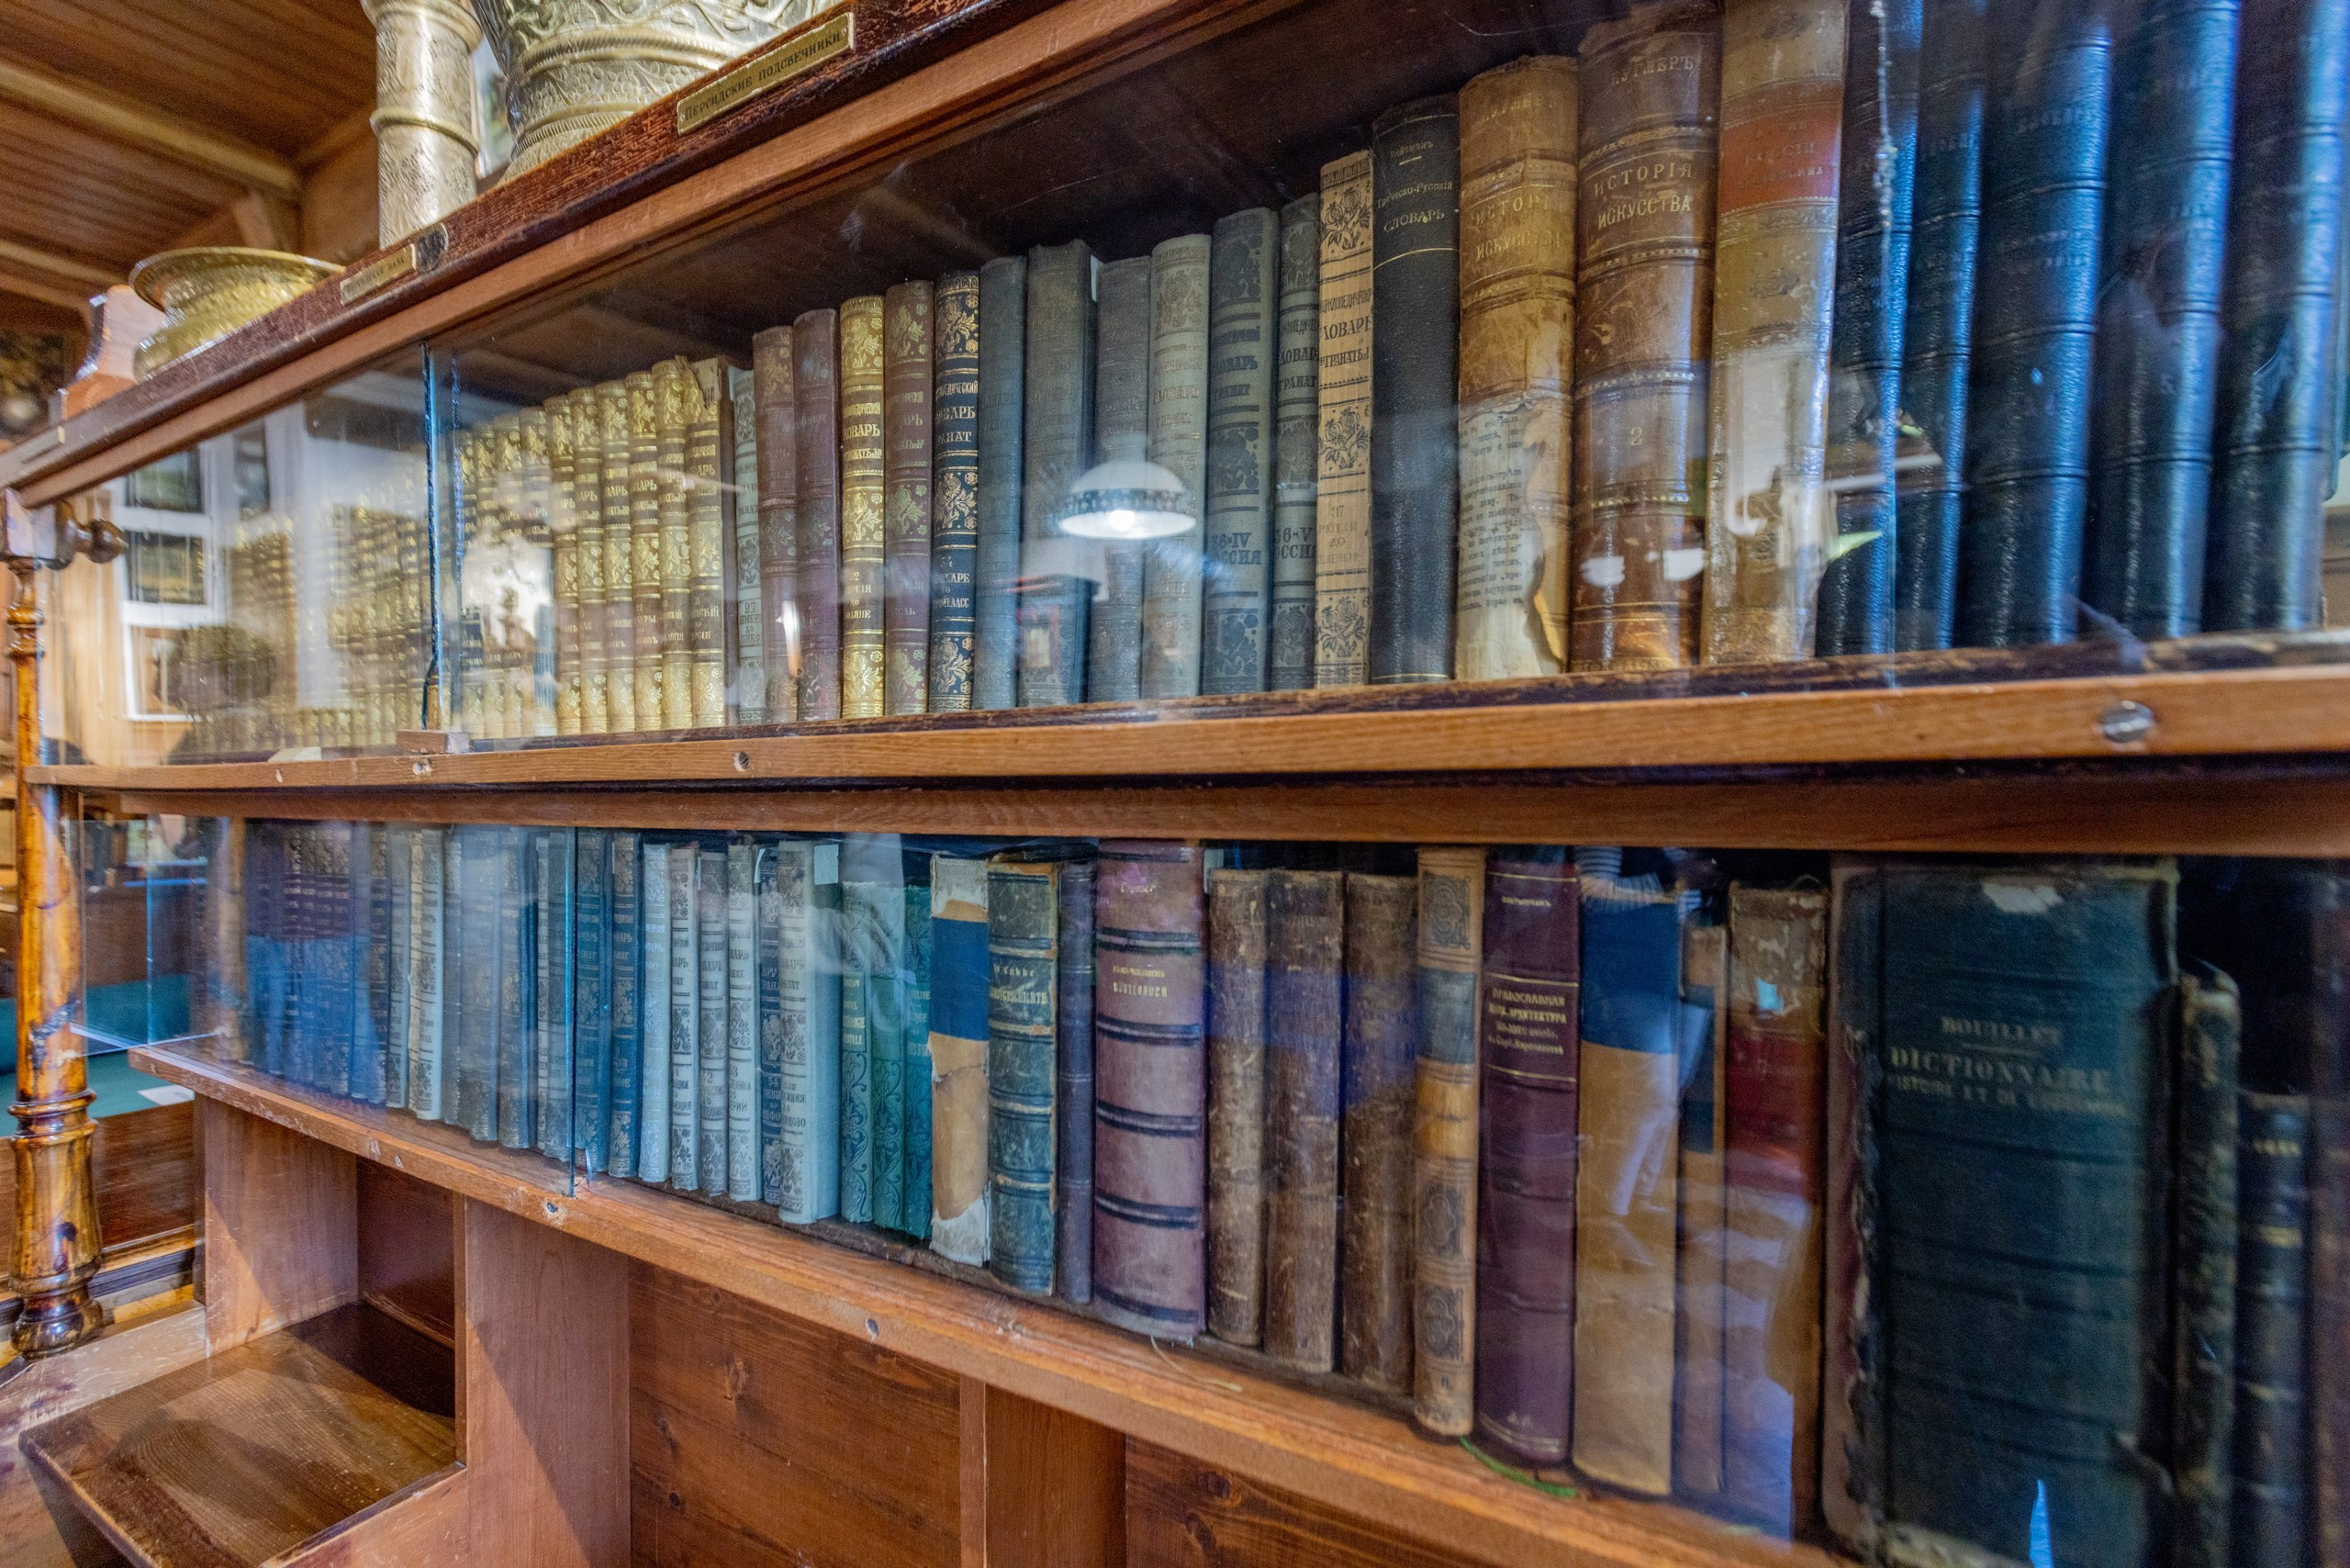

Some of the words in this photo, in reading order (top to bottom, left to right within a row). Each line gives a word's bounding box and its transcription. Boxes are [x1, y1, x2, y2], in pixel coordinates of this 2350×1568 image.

[685, 76, 753, 120] ПЕРСИДСКИЕ
[758, 31, 842, 81] ПОДСВЕЧНИКИ
[1594, 163, 1693, 196] ИСТОРІЯ
[1383, 209, 1445, 232] СЛОВАРЬ
[1597, 194, 1691, 230] ИСКУССТВА
[1630, 427, 1642, 445] 2
[1891, 1046, 2112, 1093] DICTIONNAIRE
